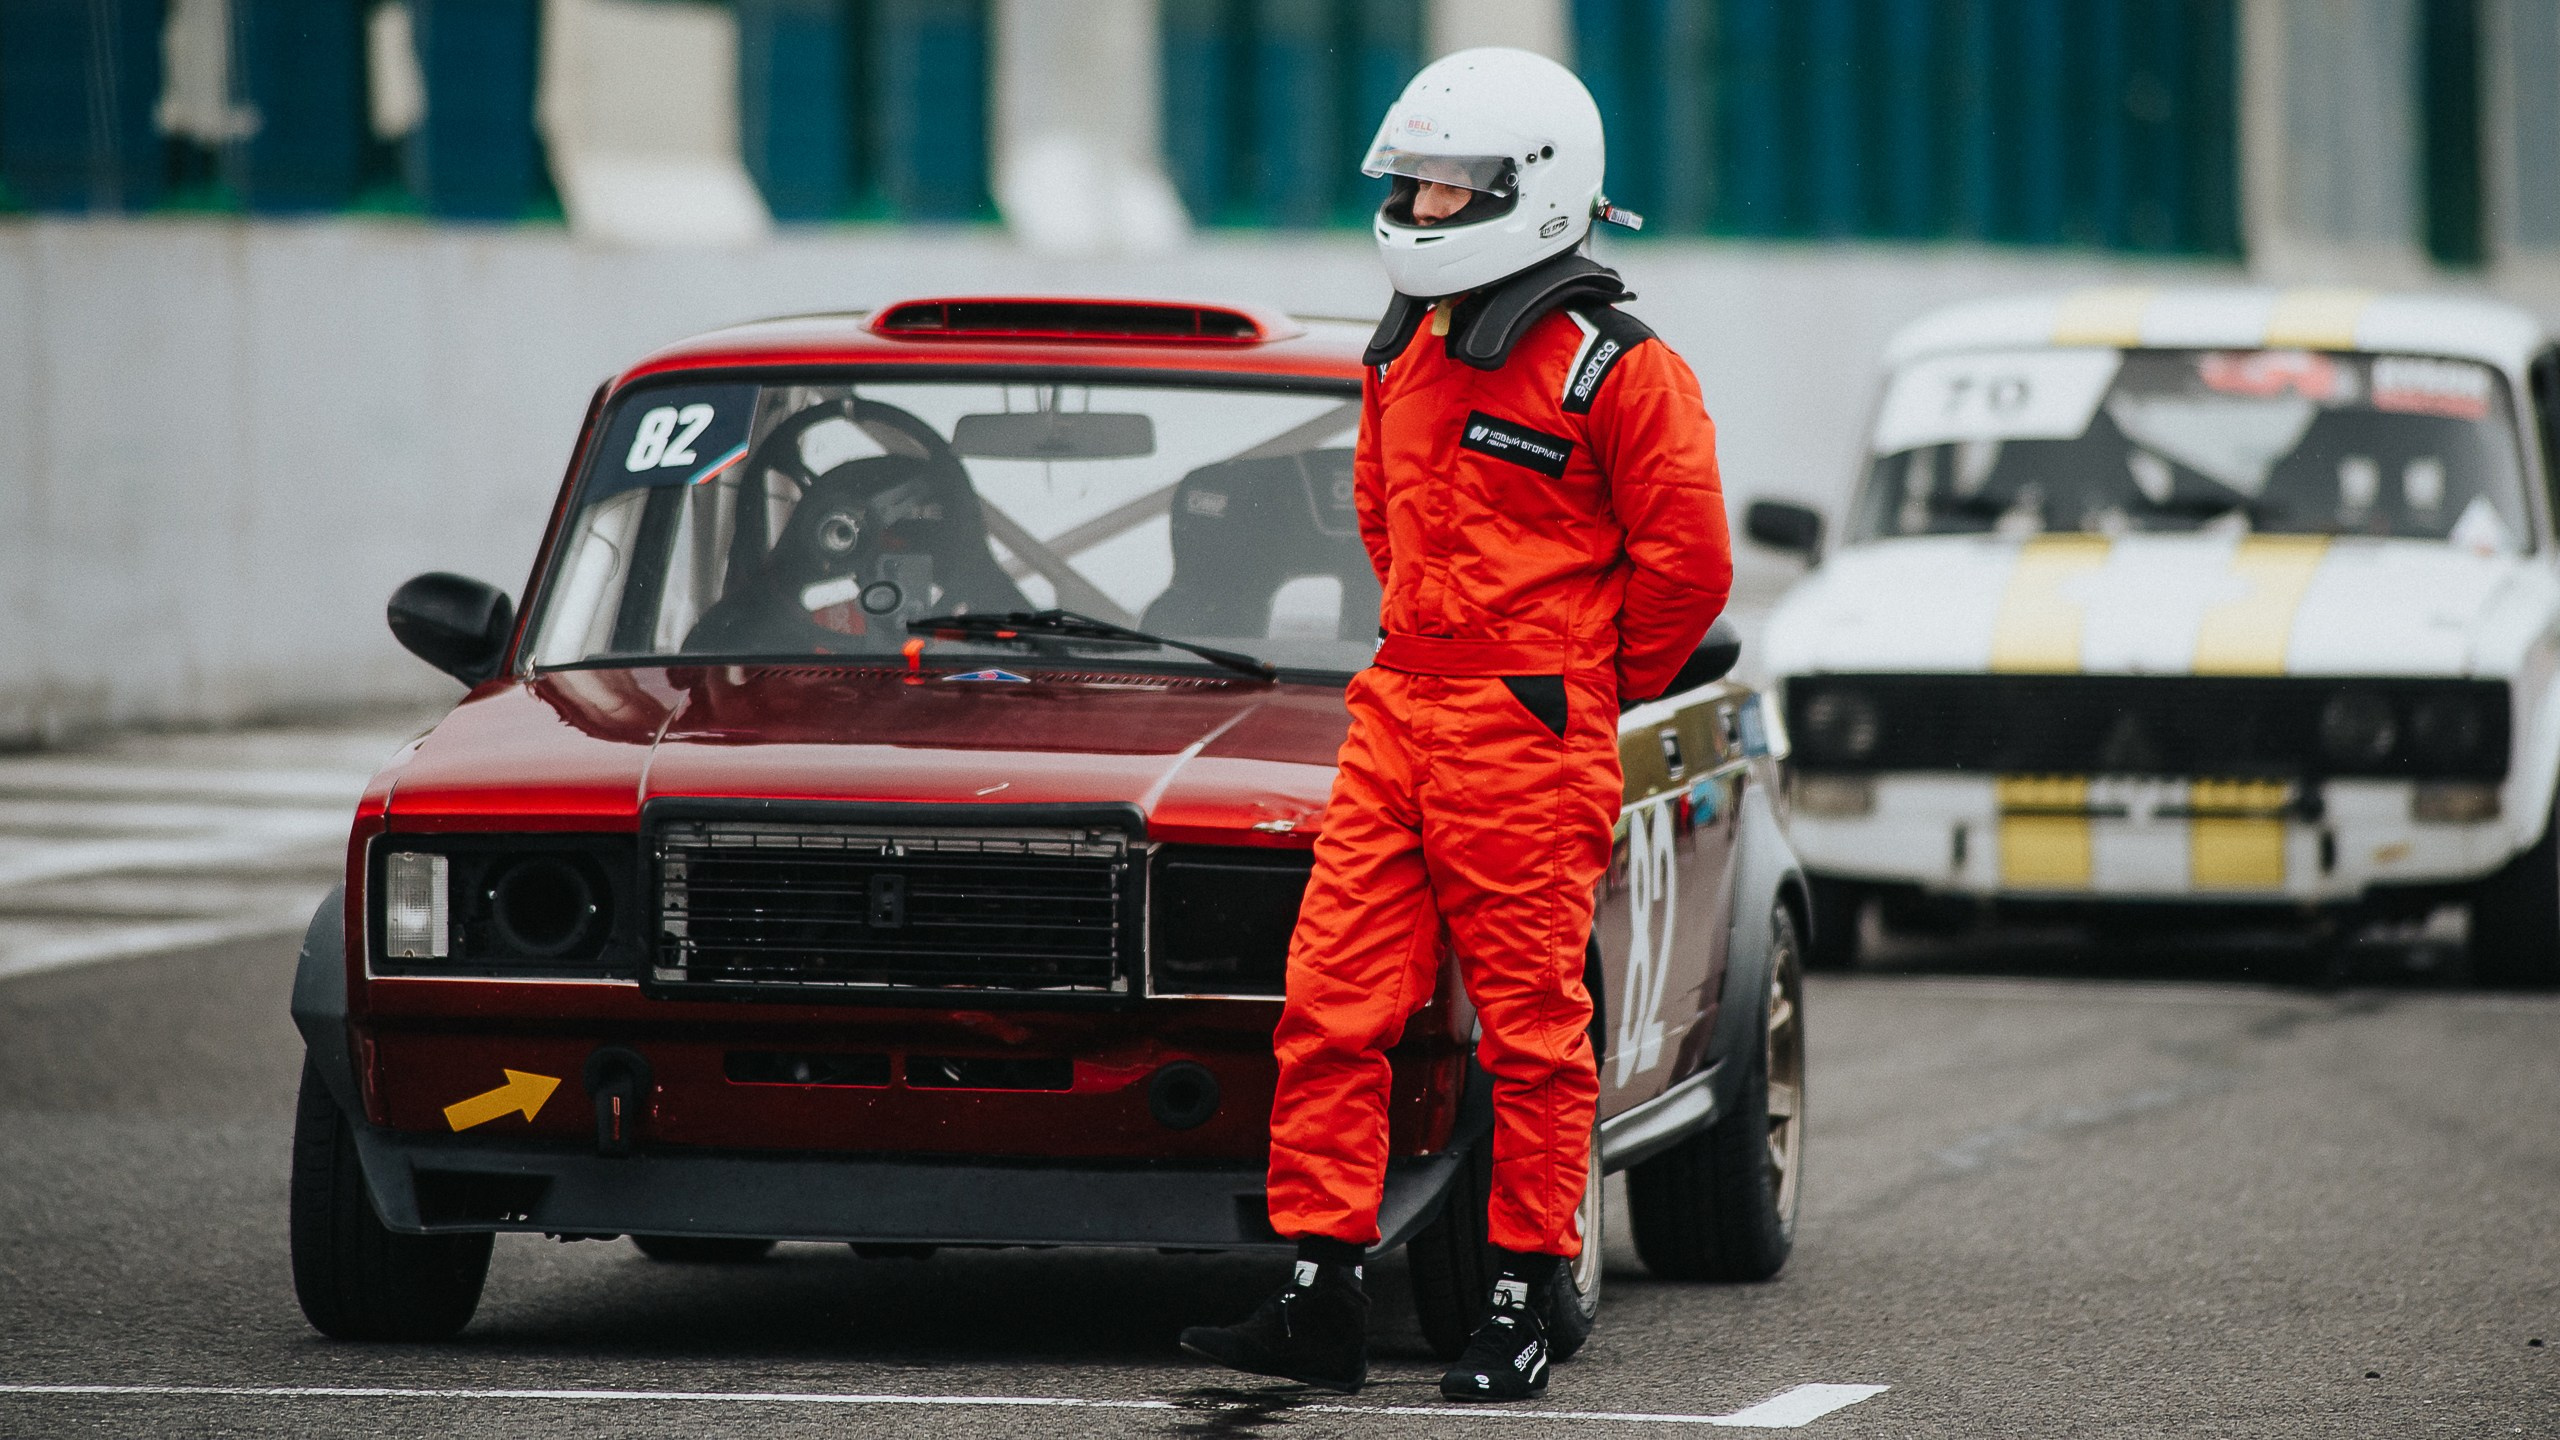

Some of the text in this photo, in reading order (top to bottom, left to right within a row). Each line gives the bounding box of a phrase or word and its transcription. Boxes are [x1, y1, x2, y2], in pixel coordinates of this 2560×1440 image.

[1408, 120, 1432, 131] BELL
[1574, 341, 1619, 400] sparco
[1941, 375, 2031, 415] 70
[625, 403, 715, 473] 82
[1489, 430, 1520, 446] НОВЫЙ
[1521, 441, 1565, 462] ВТОРМЕТ
[1616, 799, 1675, 1089] 82
[1515, 1341, 1538, 1371] sparco
